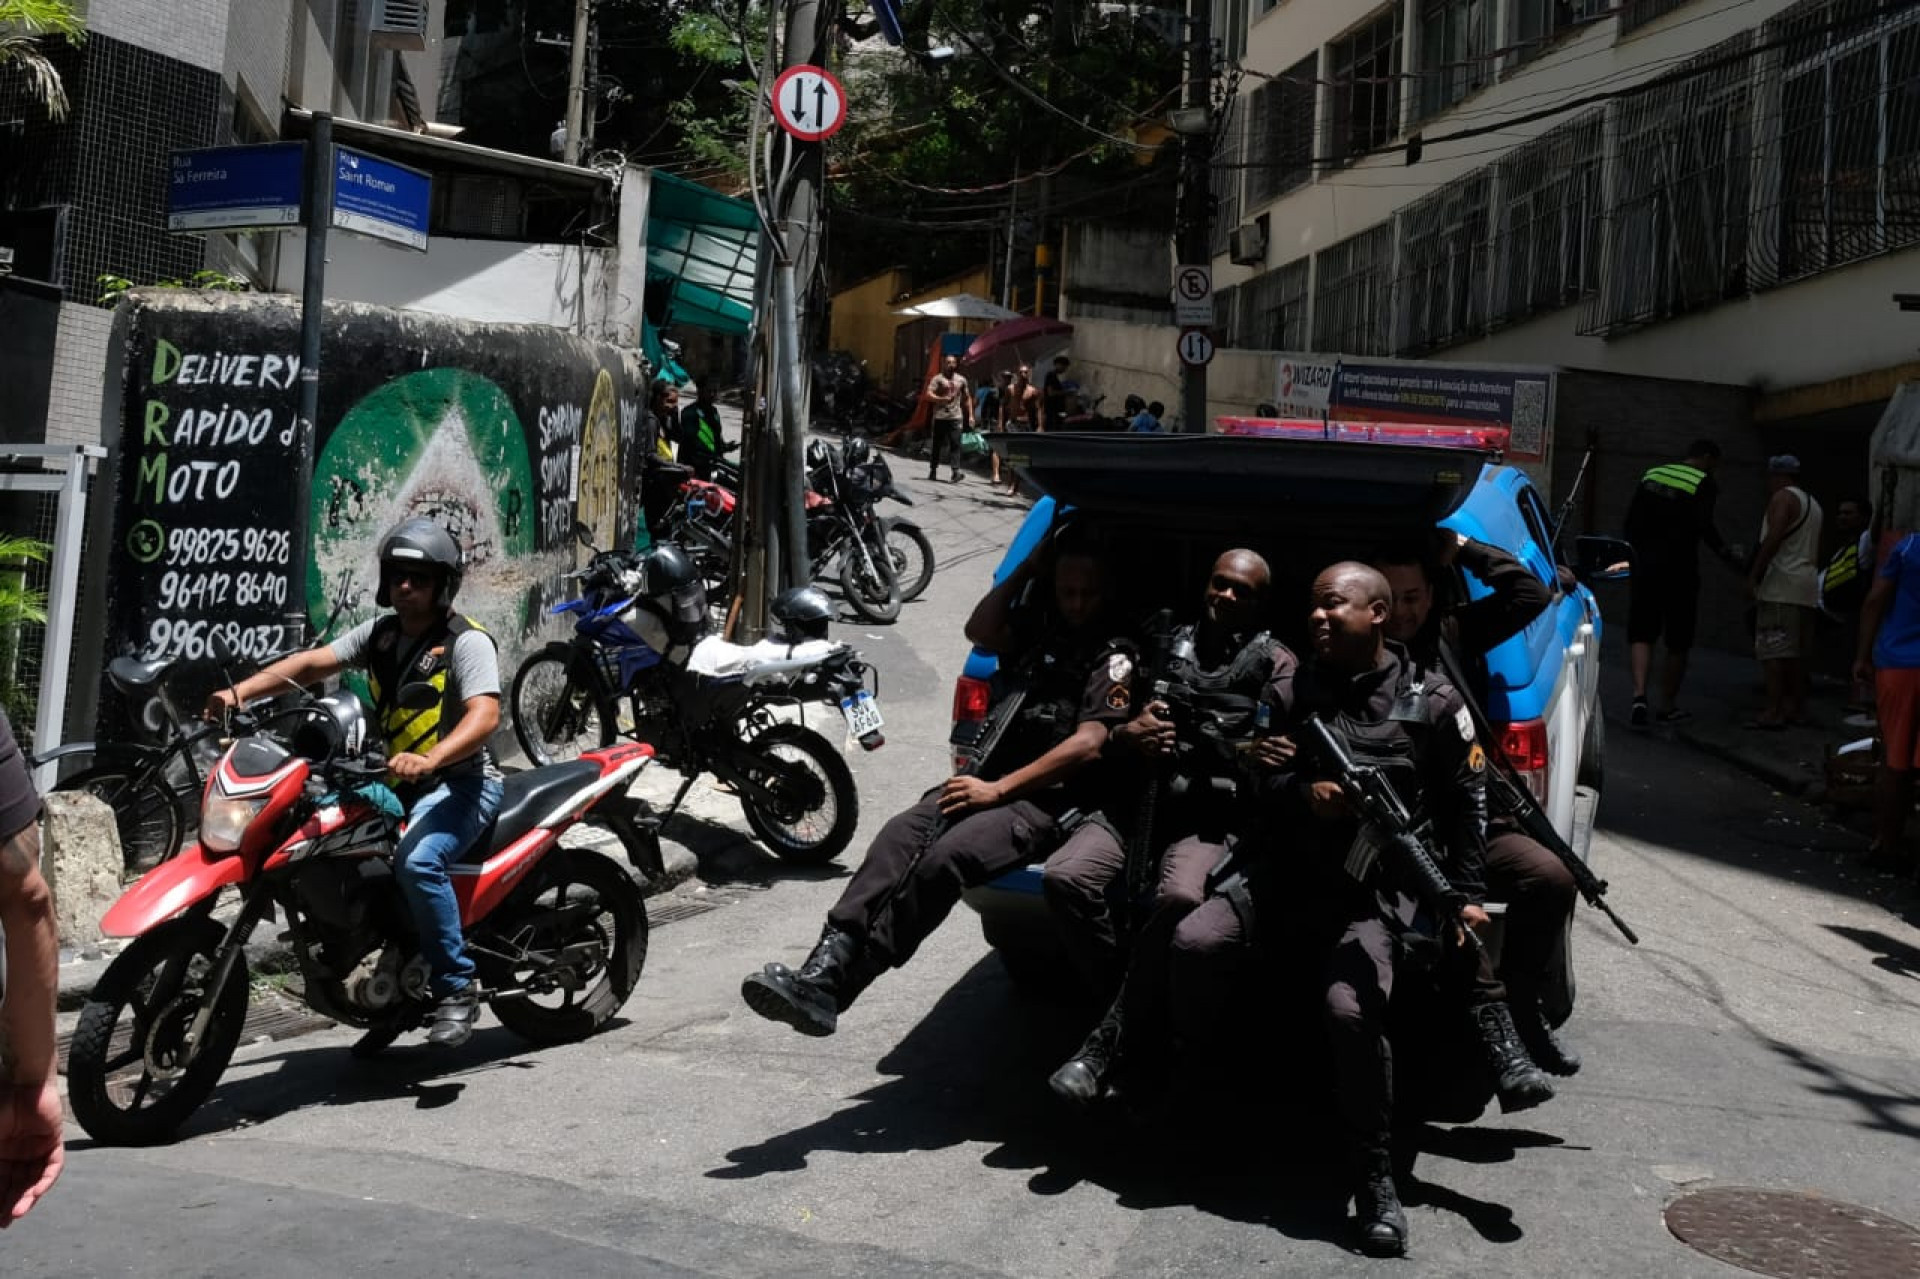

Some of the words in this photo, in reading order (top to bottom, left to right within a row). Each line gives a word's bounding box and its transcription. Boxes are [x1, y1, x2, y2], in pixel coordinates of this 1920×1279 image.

[173, 156, 192, 168] Rua
[187, 168, 228, 182] Ferreira
[338, 167, 363, 185] Saint
[365, 173, 396, 193] Roman
[1292, 363, 1331, 388] WIZARD
[136, 453, 241, 504] MOTO
[166, 527, 241, 567] 99825
[158, 570, 231, 610] 96412
[235, 570, 288, 608] 8640
